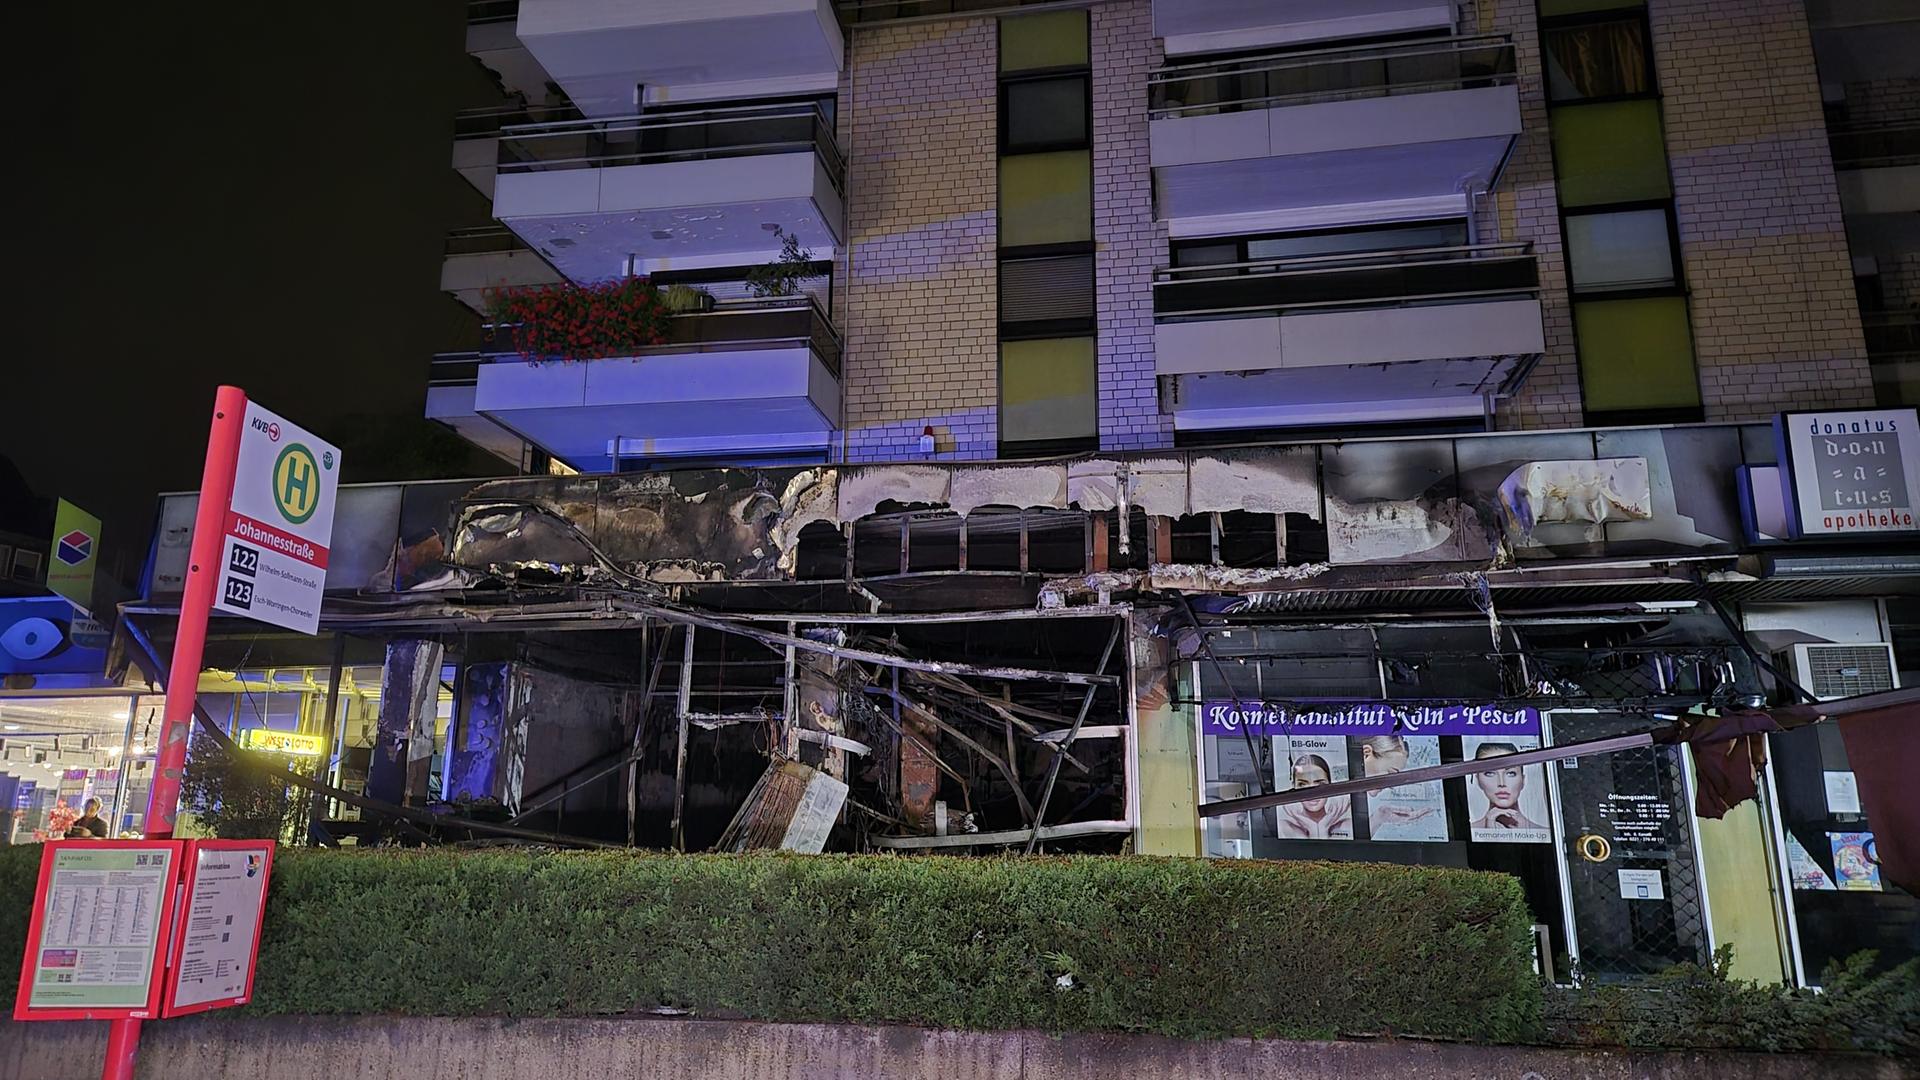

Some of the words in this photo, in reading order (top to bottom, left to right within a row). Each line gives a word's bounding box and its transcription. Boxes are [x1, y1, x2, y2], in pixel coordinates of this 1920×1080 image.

[251, 416, 269, 434] KVB
[1810, 417, 1897, 435] donatus
[284, 456, 310, 511] H
[1823, 507, 1912, 531] apotheke
[234, 517, 315, 561] Johannesstraße
[231, 547, 257, 572] 122
[226, 580, 252, 604] 123
[1291, 739, 1328, 749] BB-Glow
[1607, 792, 1659, 802] Öffnungszeiten:
[1474, 831, 1513, 839] Permanent
[1513, 831, 1548, 841] Make-Up
